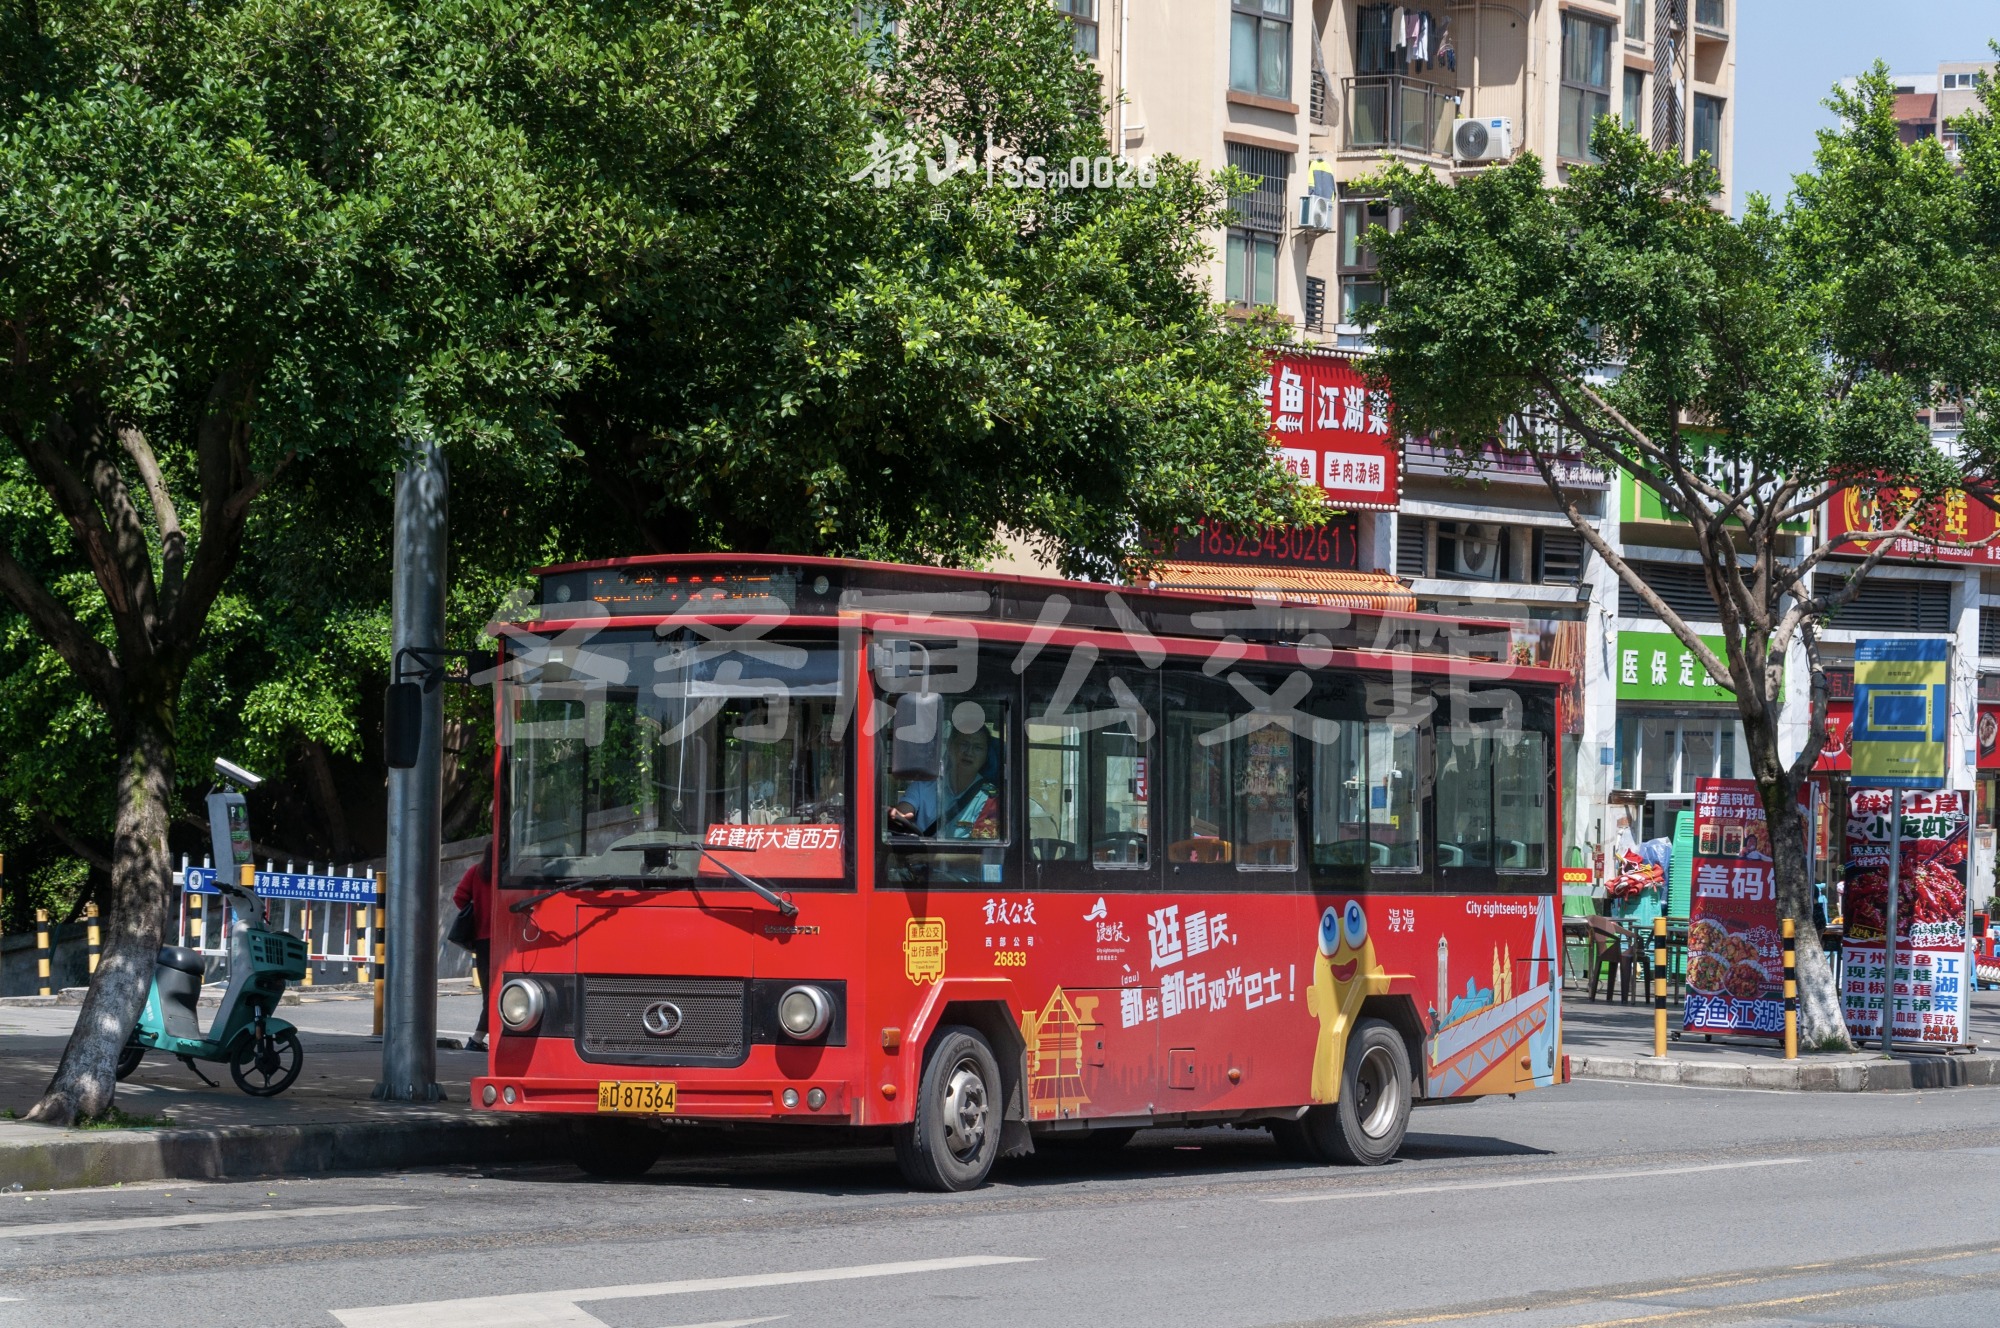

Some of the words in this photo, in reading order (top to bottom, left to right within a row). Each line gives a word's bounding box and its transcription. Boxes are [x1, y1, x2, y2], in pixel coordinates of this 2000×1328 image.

[1317, 384, 1389, 436] 江湖菜
[1329, 459, 1380, 485] 羊肉汤锅
[1697, 792, 1755, 806] 现炒盖码饭
[1866, 815, 1953, 839] 小龙虾
[708, 827, 845, 850] 往建桥大道西方
[297, 877, 335, 892] 减速慢行
[982, 898, 1037, 925] 重庆公交
[1466, 901, 1481, 917] City
[1483, 902, 1527, 918] sightseeing
[1388, 908, 1414, 933] 漫漫
[911, 926, 940, 938] 重庆公交
[1147, 904, 1237, 972] 逛重庆，
[985, 936, 1034, 948] 西部公司
[911, 945, 940, 957] 出行品牌
[993, 951, 1027, 967] 26833
[1848, 951, 1932, 967] 万州烤鱼
[1847, 966, 1932, 982] 现杀青蛙
[1847, 981, 1932, 997] 泡椒鱼蛋
[1934, 957, 1959, 1012] 江湖菜
[1846, 995, 1931, 1012] 精品干锅
[1846, 1009, 1878, 1022] 家常菜
[1892, 1011, 1917, 1023] 血旺
[1923, 1013, 1956, 1026] 荤豆花
